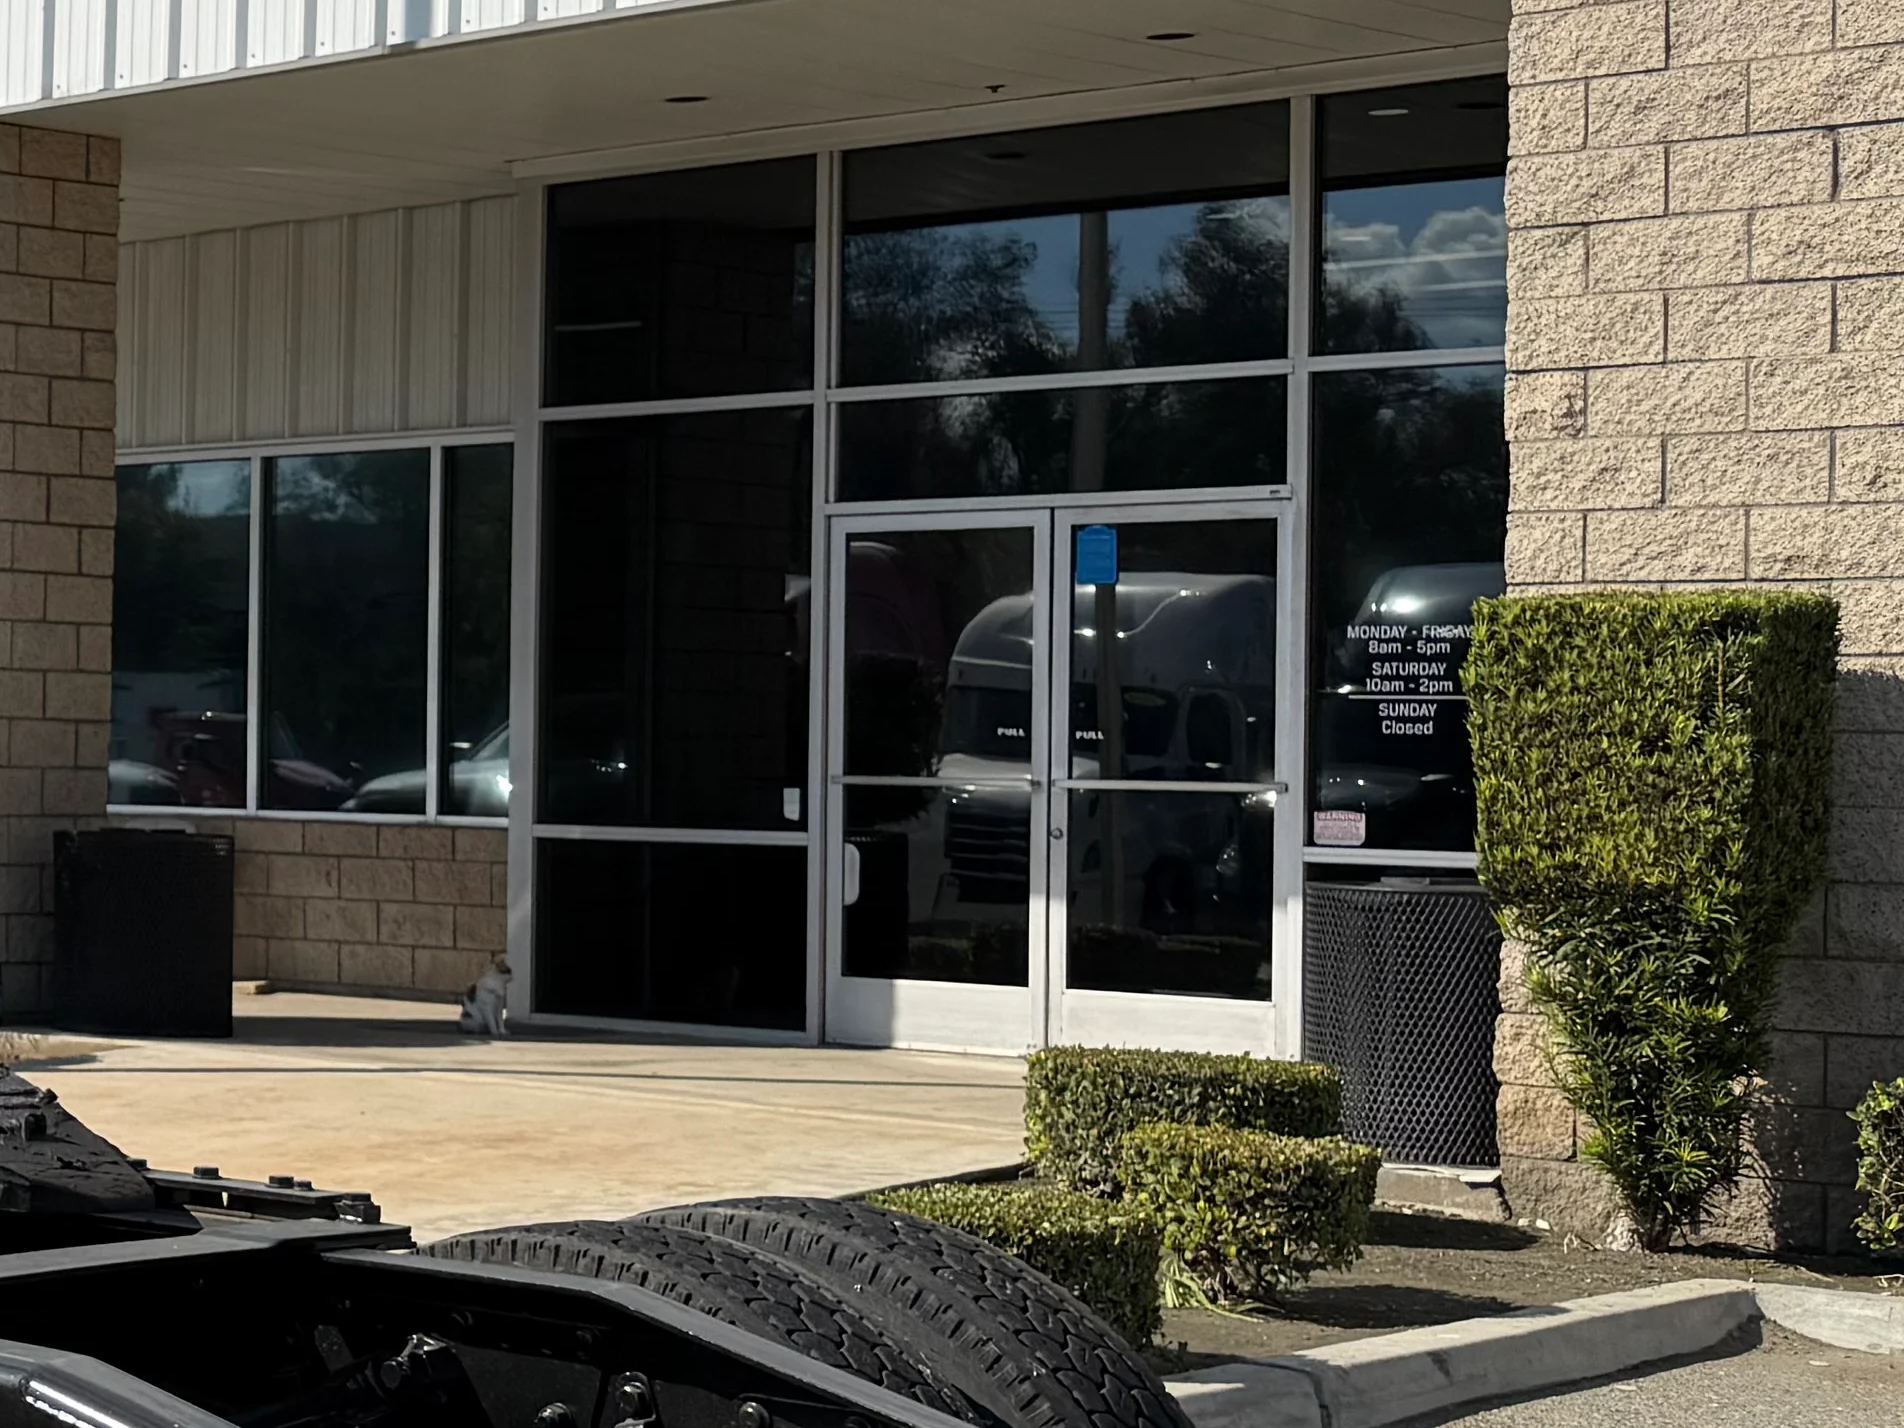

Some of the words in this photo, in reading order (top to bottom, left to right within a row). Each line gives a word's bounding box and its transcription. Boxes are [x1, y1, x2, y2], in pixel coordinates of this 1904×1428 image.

[1347, 625, 1407, 639] MONDAY
[1368, 640, 1401, 654] 8am
[1416, 640, 1450, 656] 5pm
[1372, 661, 1446, 676] SATURDAY
[1365, 678, 1404, 692] 10am
[1419, 678, 1453, 693] 2pm
[1378, 702, 1437, 717] SUNDAY
[997, 727, 1025, 737] PULL
[1381, 719, 1433, 735] Closed
[1075, 731, 1104, 740] PULL
